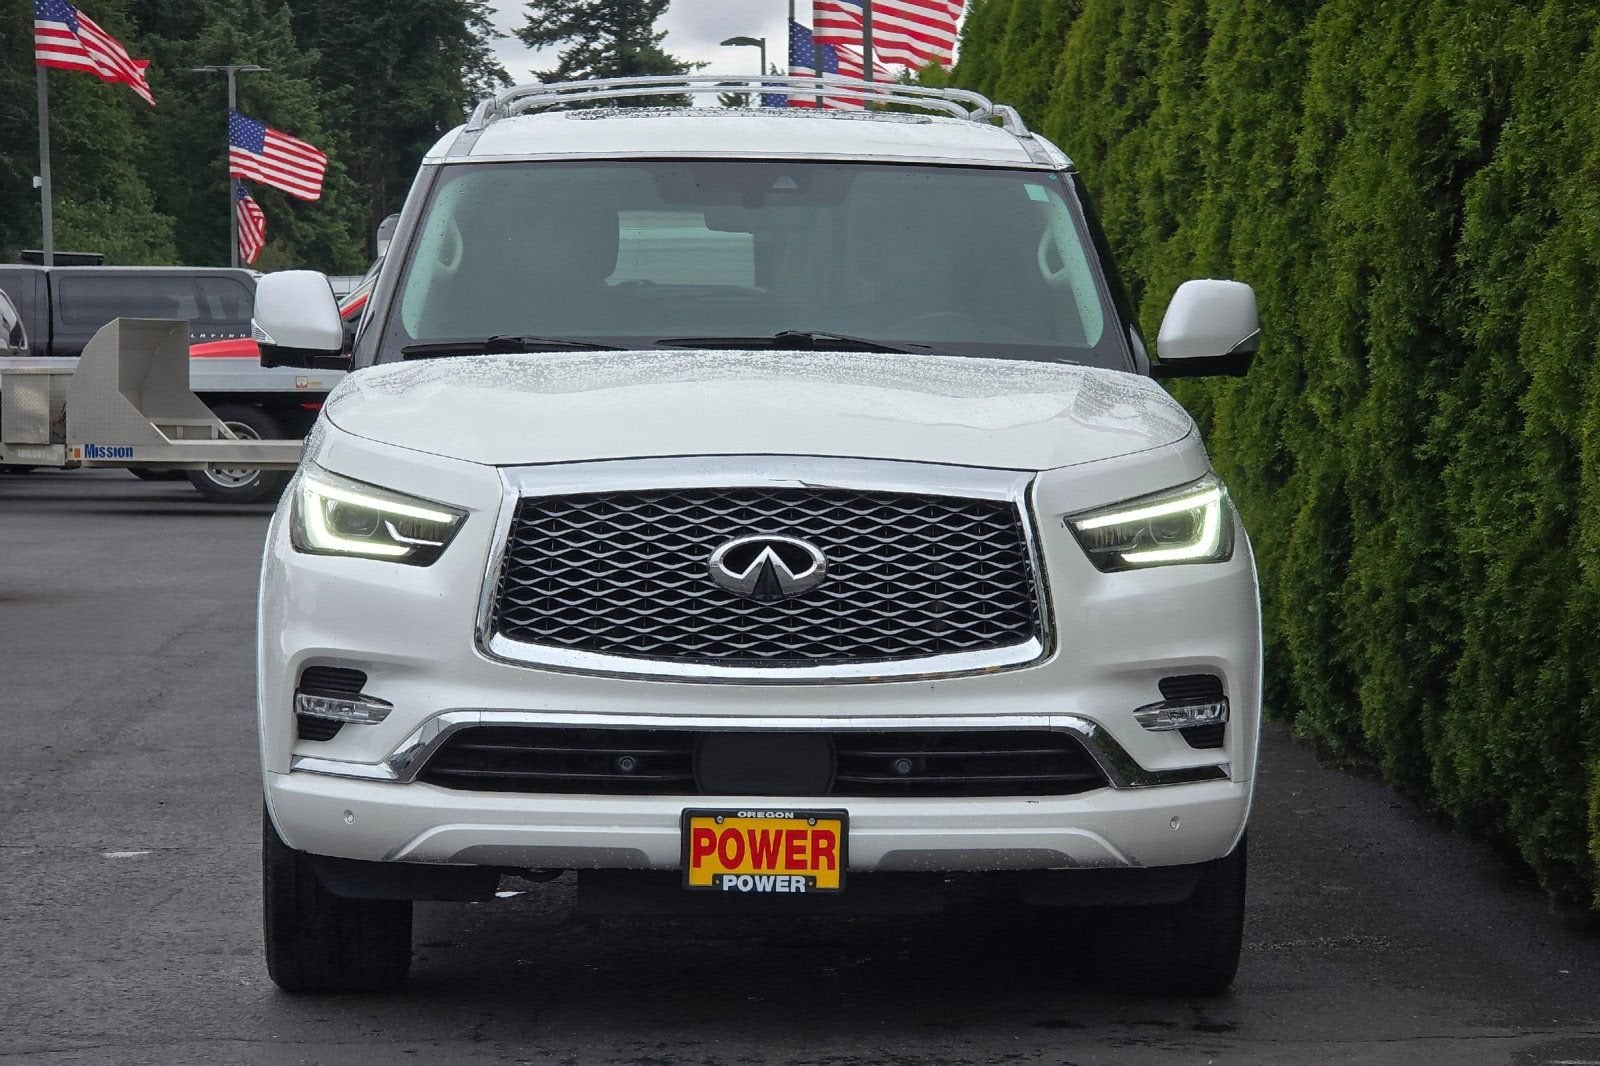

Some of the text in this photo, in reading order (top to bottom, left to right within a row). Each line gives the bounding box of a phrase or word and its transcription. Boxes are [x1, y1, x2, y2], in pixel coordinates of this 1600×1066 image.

[84, 444, 133, 458] Mission
[737, 811, 794, 819] OREGON
[692, 828, 836, 870] POWER
[722, 875, 806, 893] POWER
